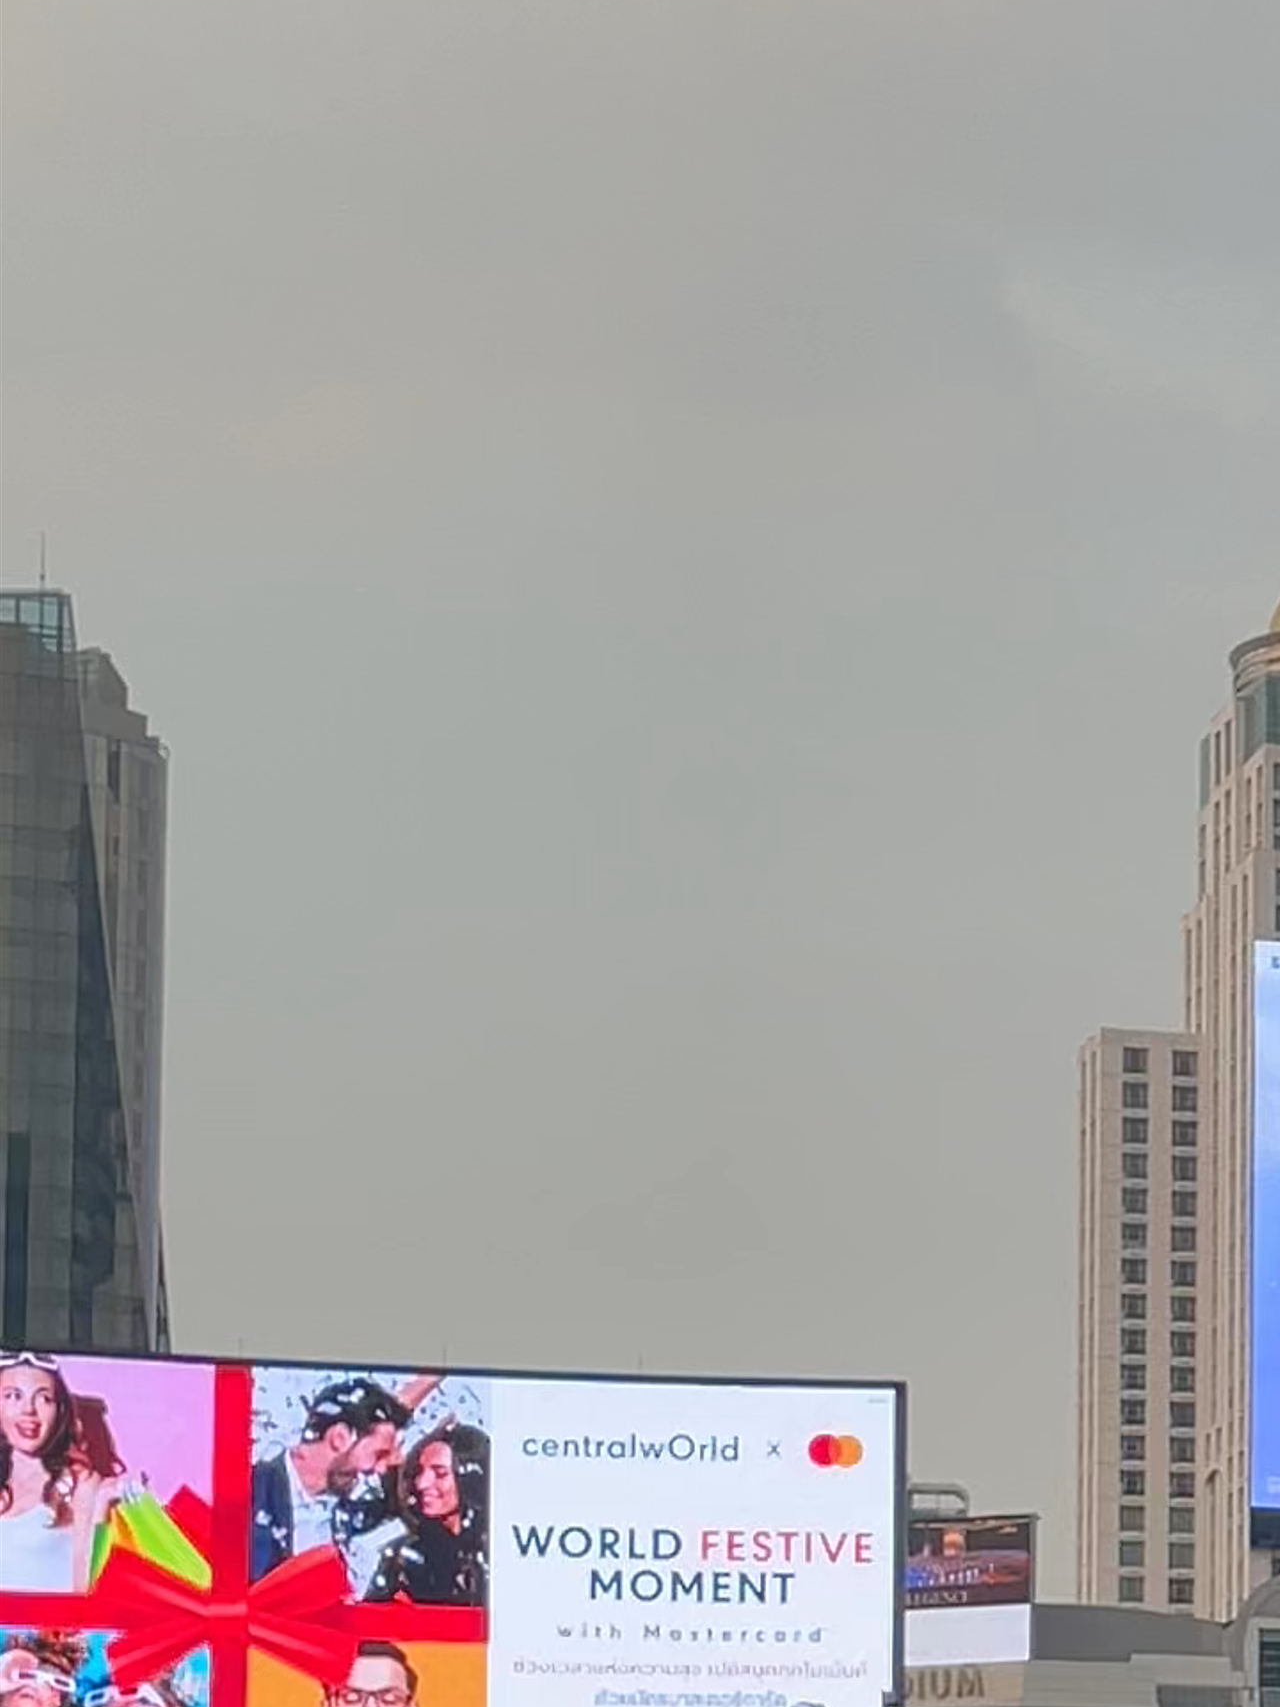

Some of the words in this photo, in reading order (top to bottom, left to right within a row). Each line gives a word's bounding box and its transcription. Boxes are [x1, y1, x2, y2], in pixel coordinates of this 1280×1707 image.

[511, 1524, 683, 1561] WORLD
[701, 1529, 874, 1564] FESTIVE
[589, 1568, 796, 1605] MOMENT
[557, 1623, 622, 1640] with
